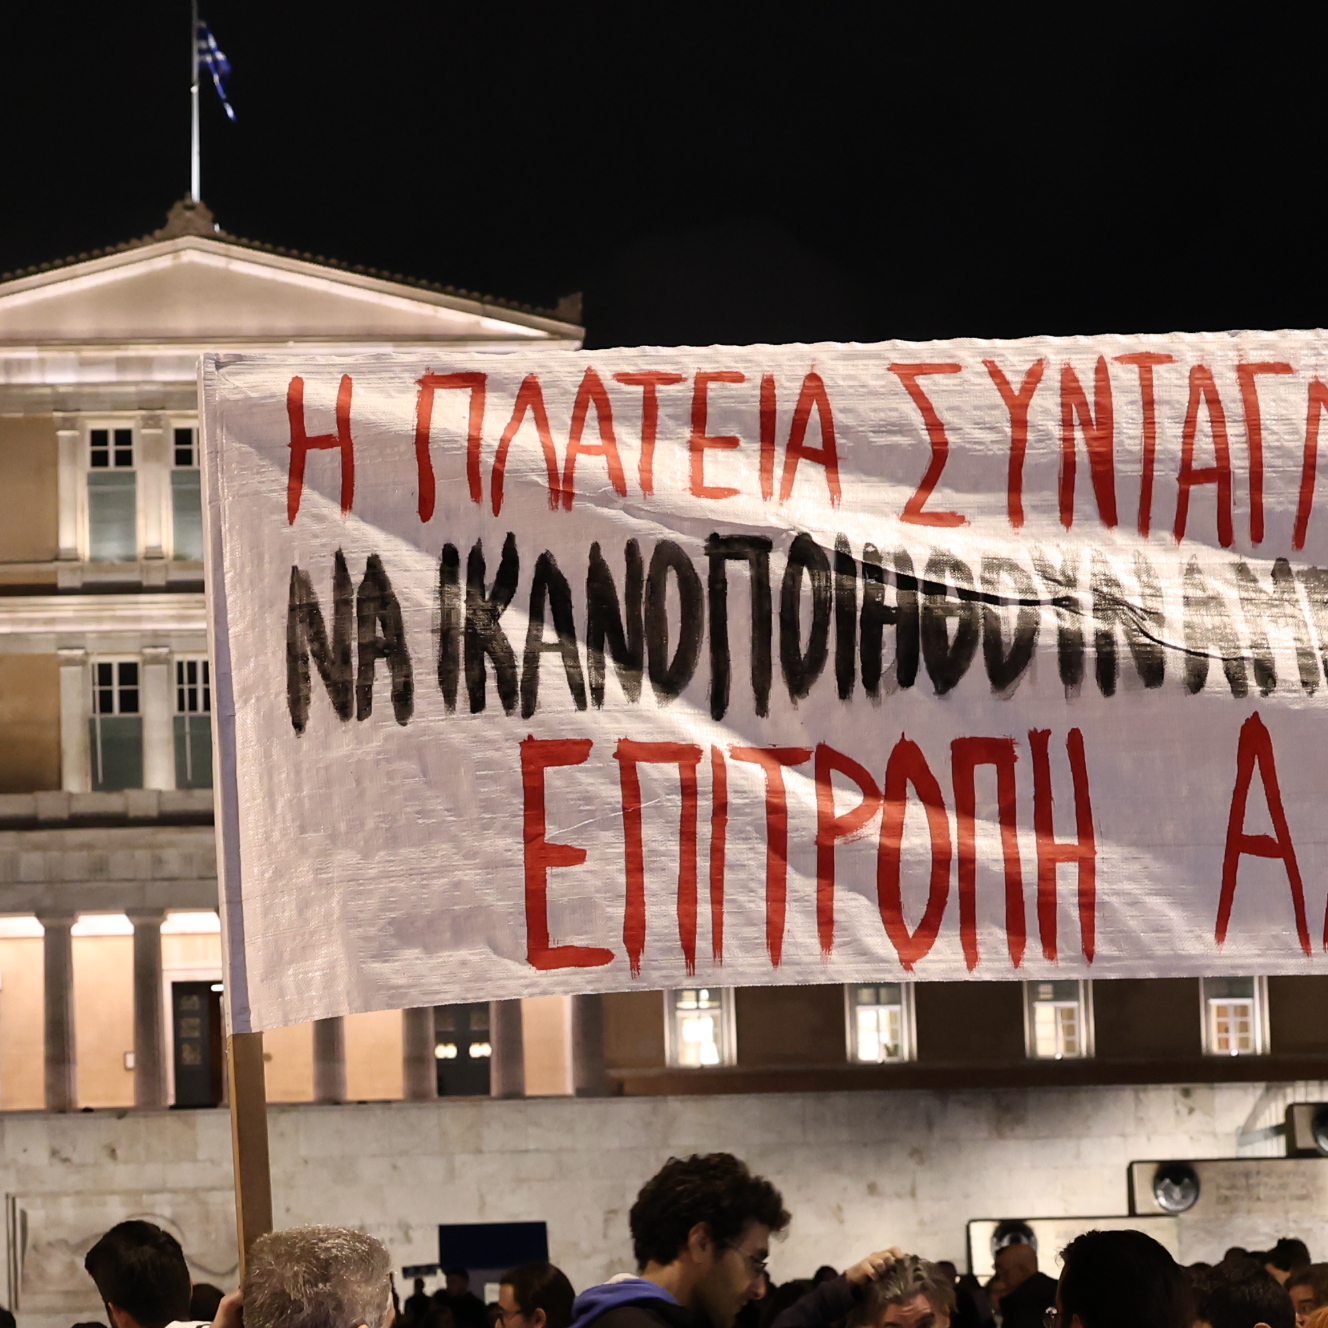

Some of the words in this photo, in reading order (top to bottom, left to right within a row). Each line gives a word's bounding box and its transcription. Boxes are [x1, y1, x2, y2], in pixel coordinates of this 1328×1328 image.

[286, 373, 354, 525] Η
[415, 365, 844, 522] ΠΛΑΤΕΙΑ
[286, 545, 415, 737] ΝΑ
[437, 530, 1166, 722] ΙΚΑΝΟΠΟΙΗΘΟΥΝ
[520, 724, 1097, 978] ΕΠΙΤΡΟΠΗ
